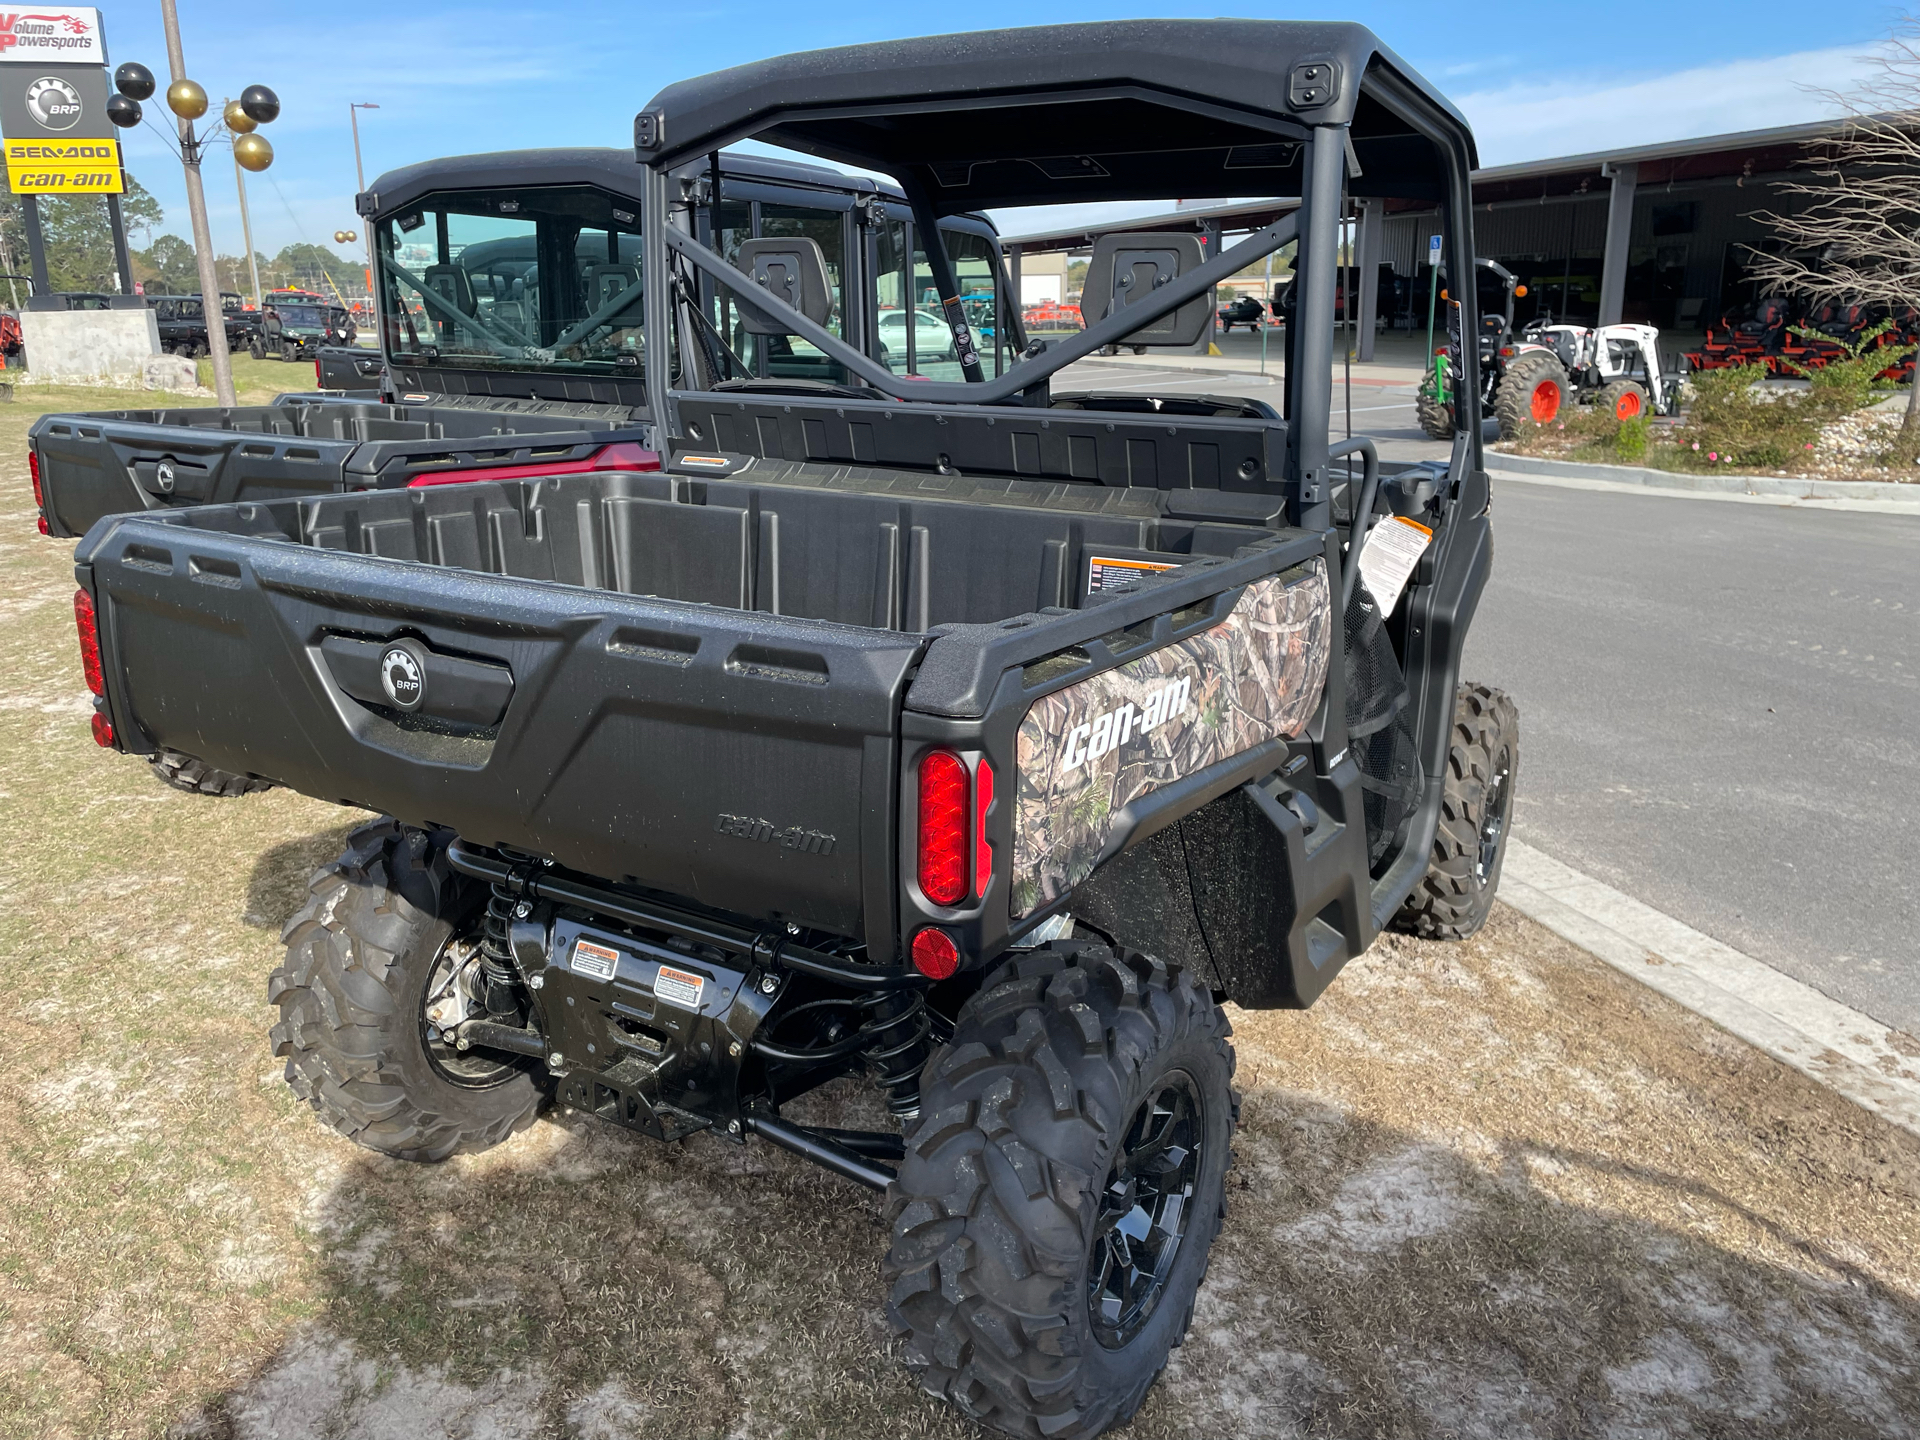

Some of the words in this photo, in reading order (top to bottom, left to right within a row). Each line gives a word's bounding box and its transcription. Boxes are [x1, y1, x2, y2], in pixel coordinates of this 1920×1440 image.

[0, 13, 55, 35] Volume
[0, 33, 92, 53] Powersports
[49, 105, 80, 115] BRP
[19, 173, 113, 186] can-am
[397, 680, 418, 690] BRP
[1062, 675, 1191, 773] can-am
[713, 812, 836, 856] can-am
[588, 946, 611, 957] WARNING
[672, 971, 696, 983] WARNING
